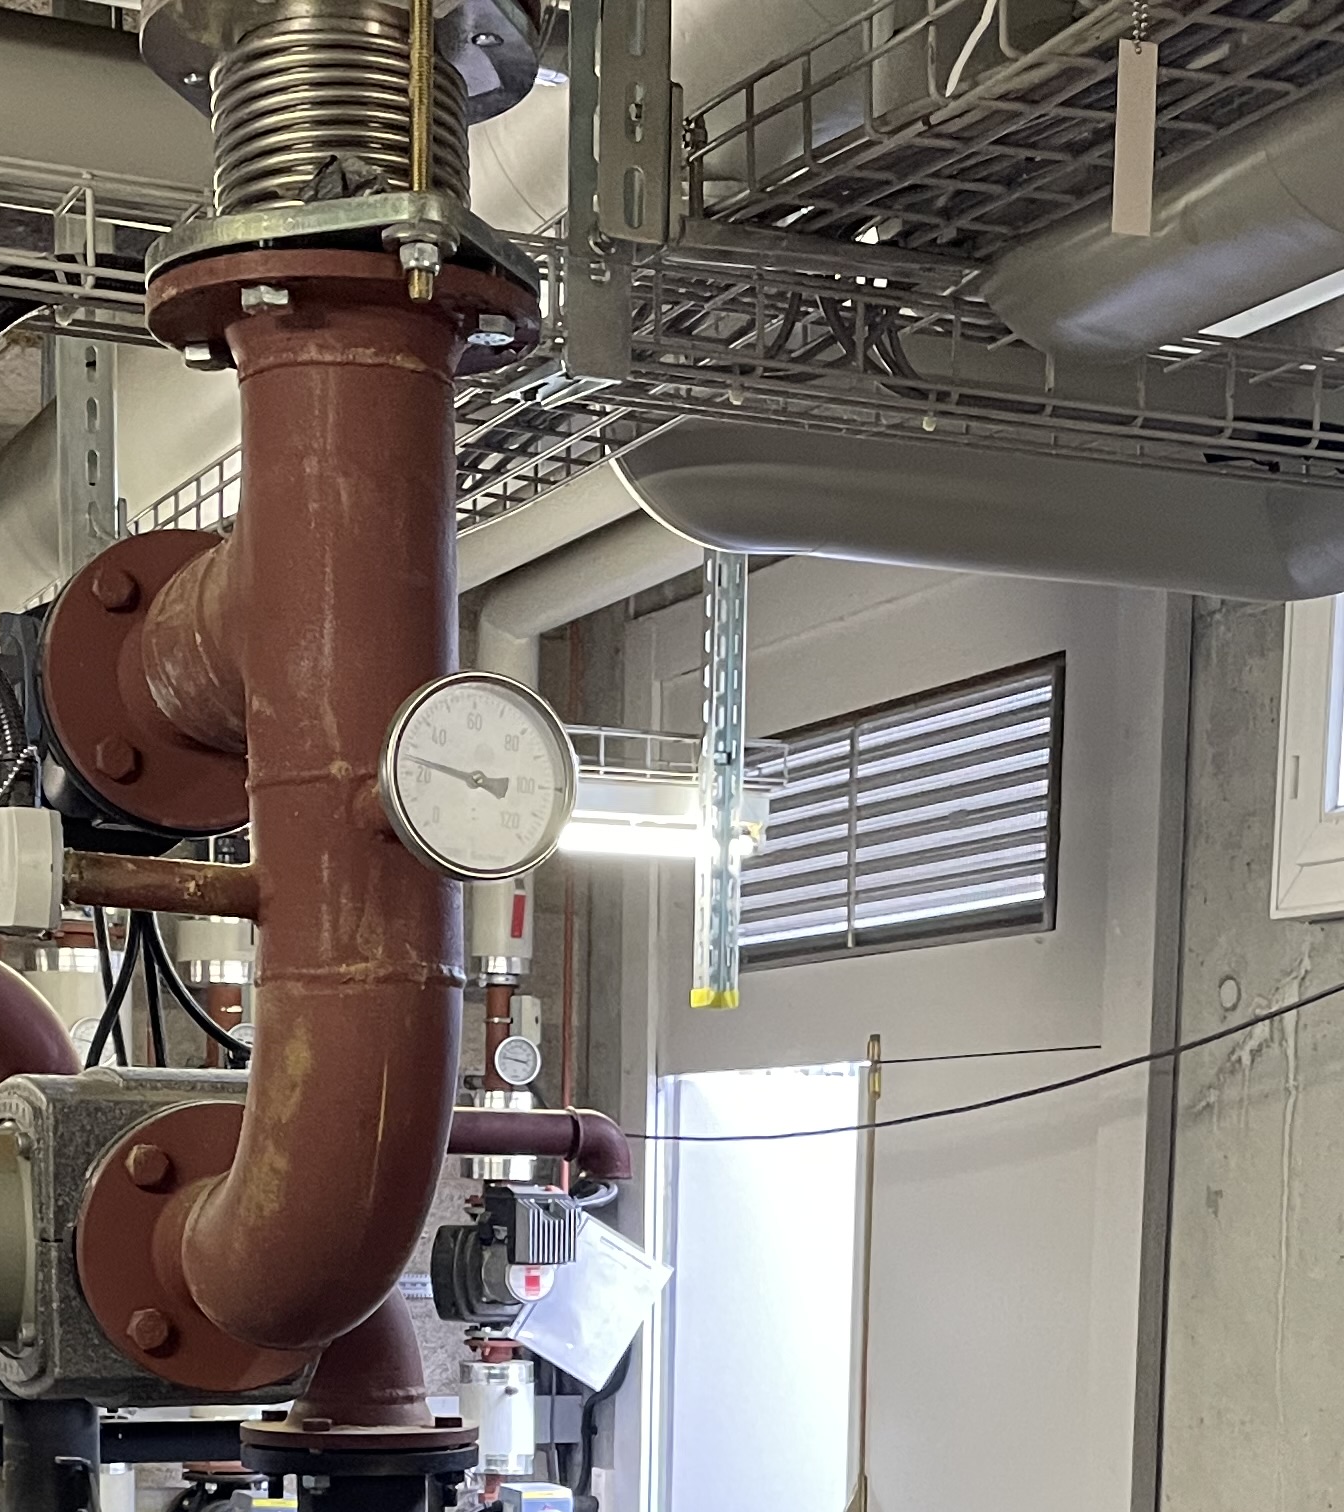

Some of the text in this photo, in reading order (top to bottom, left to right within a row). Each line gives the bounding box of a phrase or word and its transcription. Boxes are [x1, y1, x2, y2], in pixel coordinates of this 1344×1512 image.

[467, 713, 482, 731] 60
[432, 728, 447, 746] 40
[505, 734, 519, 751] 80
[416, 766, 432, 784] 20
[516, 777, 534, 794] 100
[432, 806, 440, 824] 0
[500, 811, 520, 829] 120
